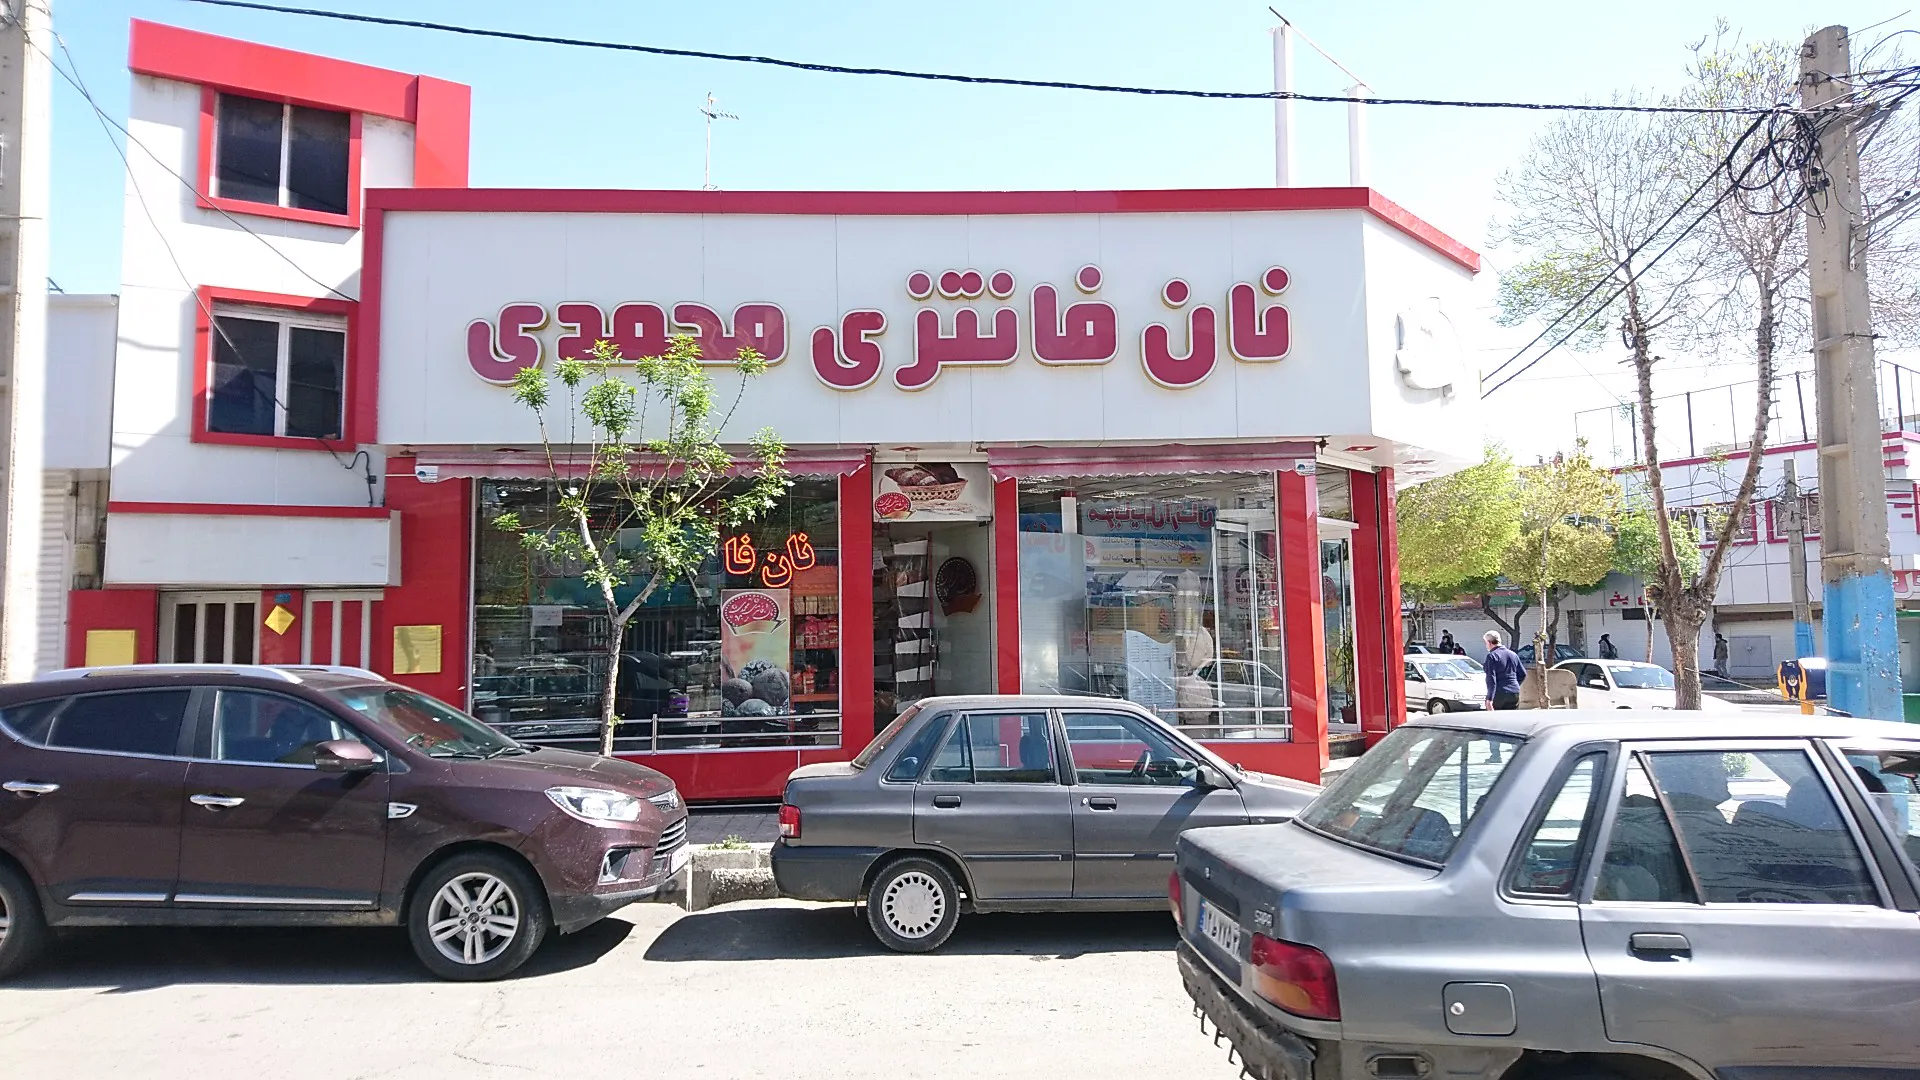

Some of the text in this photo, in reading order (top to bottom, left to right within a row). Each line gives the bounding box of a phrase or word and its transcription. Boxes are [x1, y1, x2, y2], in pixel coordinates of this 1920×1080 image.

[468, 265, 1291, 390] نان فانتزی محمدی
[762, 532, 816, 588] نان
